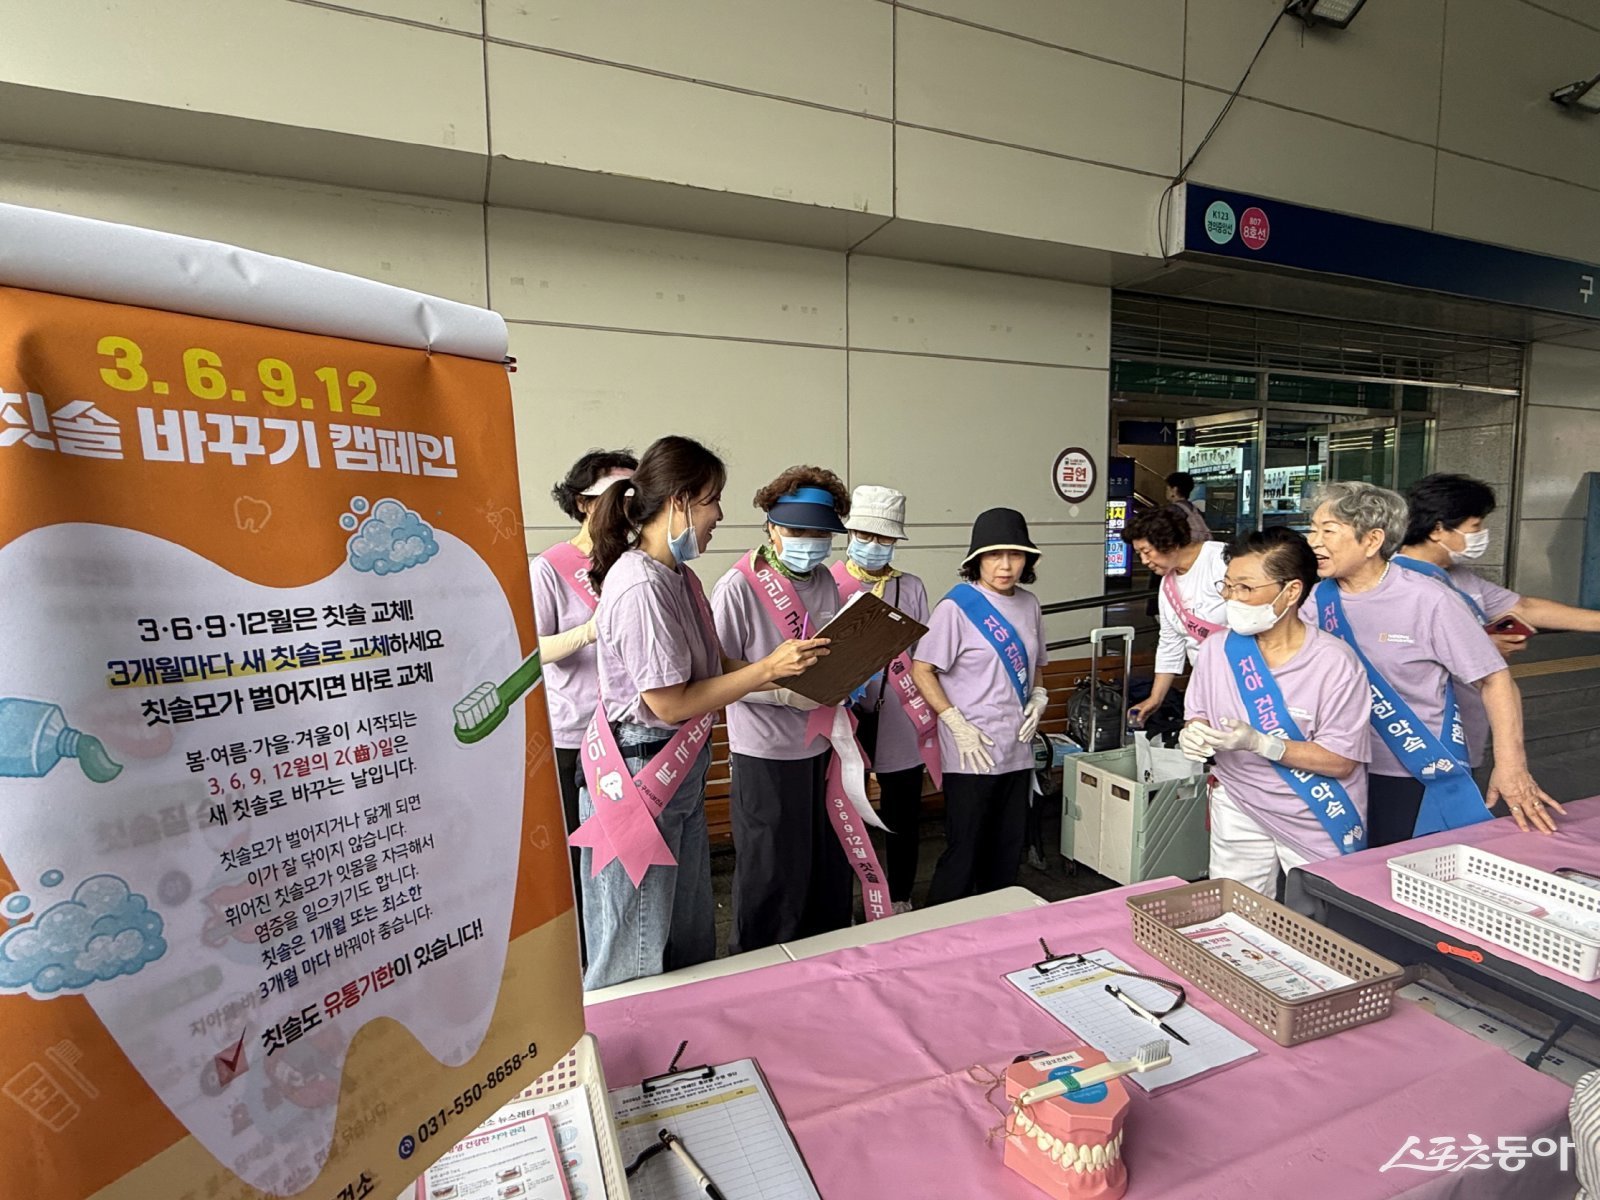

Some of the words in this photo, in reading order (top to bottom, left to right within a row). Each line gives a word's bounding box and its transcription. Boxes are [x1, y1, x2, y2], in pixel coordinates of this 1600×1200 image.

[1212, 210, 1229, 220] K123
[1243, 226, 1267, 241] 8호선
[138, 407, 321, 468] 바꾸기
[329, 423, 458, 478] 캠페인
[1063, 466, 1087, 482] 금연
[322, 602, 367, 628] 칫솔
[371, 600, 415, 623] 교체!
[756, 569, 792, 612] 우리는
[983, 614, 1010, 643] 치아
[107, 652, 235, 686] 3개월마다
[240, 648, 267, 673] 새
[270, 639, 346, 671] 칫솔로
[350, 629, 445, 659] 교체하세요
[1323, 601, 1340, 632] 치아
[1387, 718, 1427, 753] 약속
[141, 688, 244, 727] 칫솔모가
[249, 674, 348, 711] 벌어지면
[351, 668, 394, 693] 바로
[397, 661, 434, 687] 교체
[898, 673, 926, 710] 바꾸는
[356, 710, 418, 737] 시작되는
[1239, 655, 1264, 692] 치아
[1311, 782, 1345, 819] 약속
[209, 803, 229, 827] 새
[232, 789, 288, 820] 칫솔로
[292, 777, 345, 802] 바꾸는
[351, 756, 417, 790] 날입니다.
[273, 752, 329, 780] 12월의
[655, 761, 678, 787] 날
[220, 836, 282, 872] 칫솔모가
[285, 813, 361, 849] 벌어지거나
[364, 802, 392, 825] 닳게
[395, 794, 421, 815] 되면
[248, 863, 279, 887] 이가
[282, 856, 297, 876] 잘
[301, 841, 345, 869] 닦이지
[349, 821, 407, 853] 않습니다.
[225, 894, 271, 927] 휘어진
[274, 870, 333, 907] 칫솔모가
[336, 853, 378, 883] 잇몸을
[382, 834, 435, 864] 자극해서
[857, 862, 880, 884] 칫솔
[254, 910, 298, 944] 염증을
[302, 880, 373, 922] 일으키기도
[376, 864, 419, 892] 합니다.
[261, 935, 306, 970] 칫솔은
[310, 917, 347, 944] 1개월
[350, 904, 378, 928] 또는
[382, 884, 423, 913] 최소한
[868, 889, 886, 921] 바꾸
[259, 965, 299, 999] 3개월
[302, 950, 331, 976] 마다
[334, 929, 376, 960] 바꿔야
[378, 904, 433, 940] 좋습니다.
[261, 1003, 323, 1057] 칫솔도
[323, 953, 412, 1018] 유통기한이
[414, 918, 484, 969] 있습니다!
[417, 1042, 538, 1144] 031-550-8658~9
[498, 1108, 535, 1123] 뉴스레터
